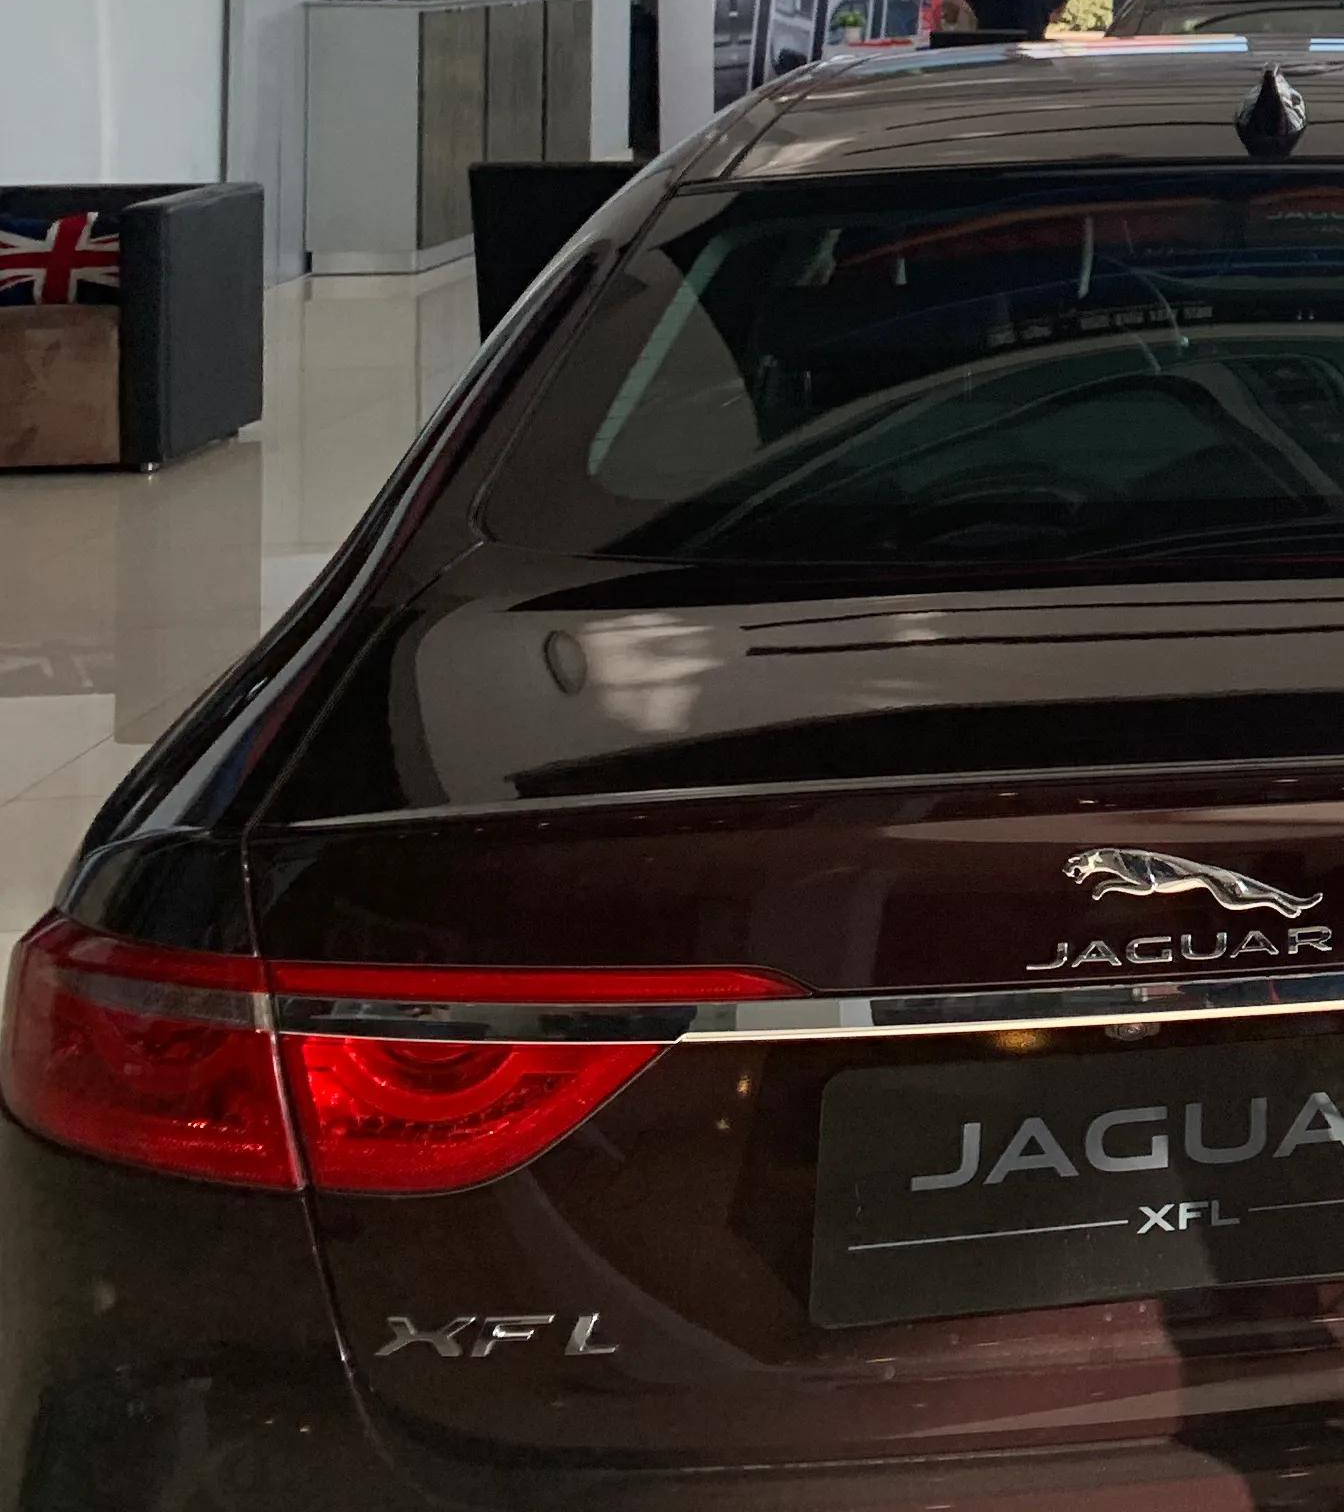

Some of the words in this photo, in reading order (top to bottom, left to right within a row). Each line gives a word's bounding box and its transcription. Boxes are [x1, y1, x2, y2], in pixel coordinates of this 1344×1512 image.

[1026, 925, 1333, 971] JAGUAR
[1136, 1199, 1241, 1235] XFL
[374, 1313, 620, 1358] XFL
